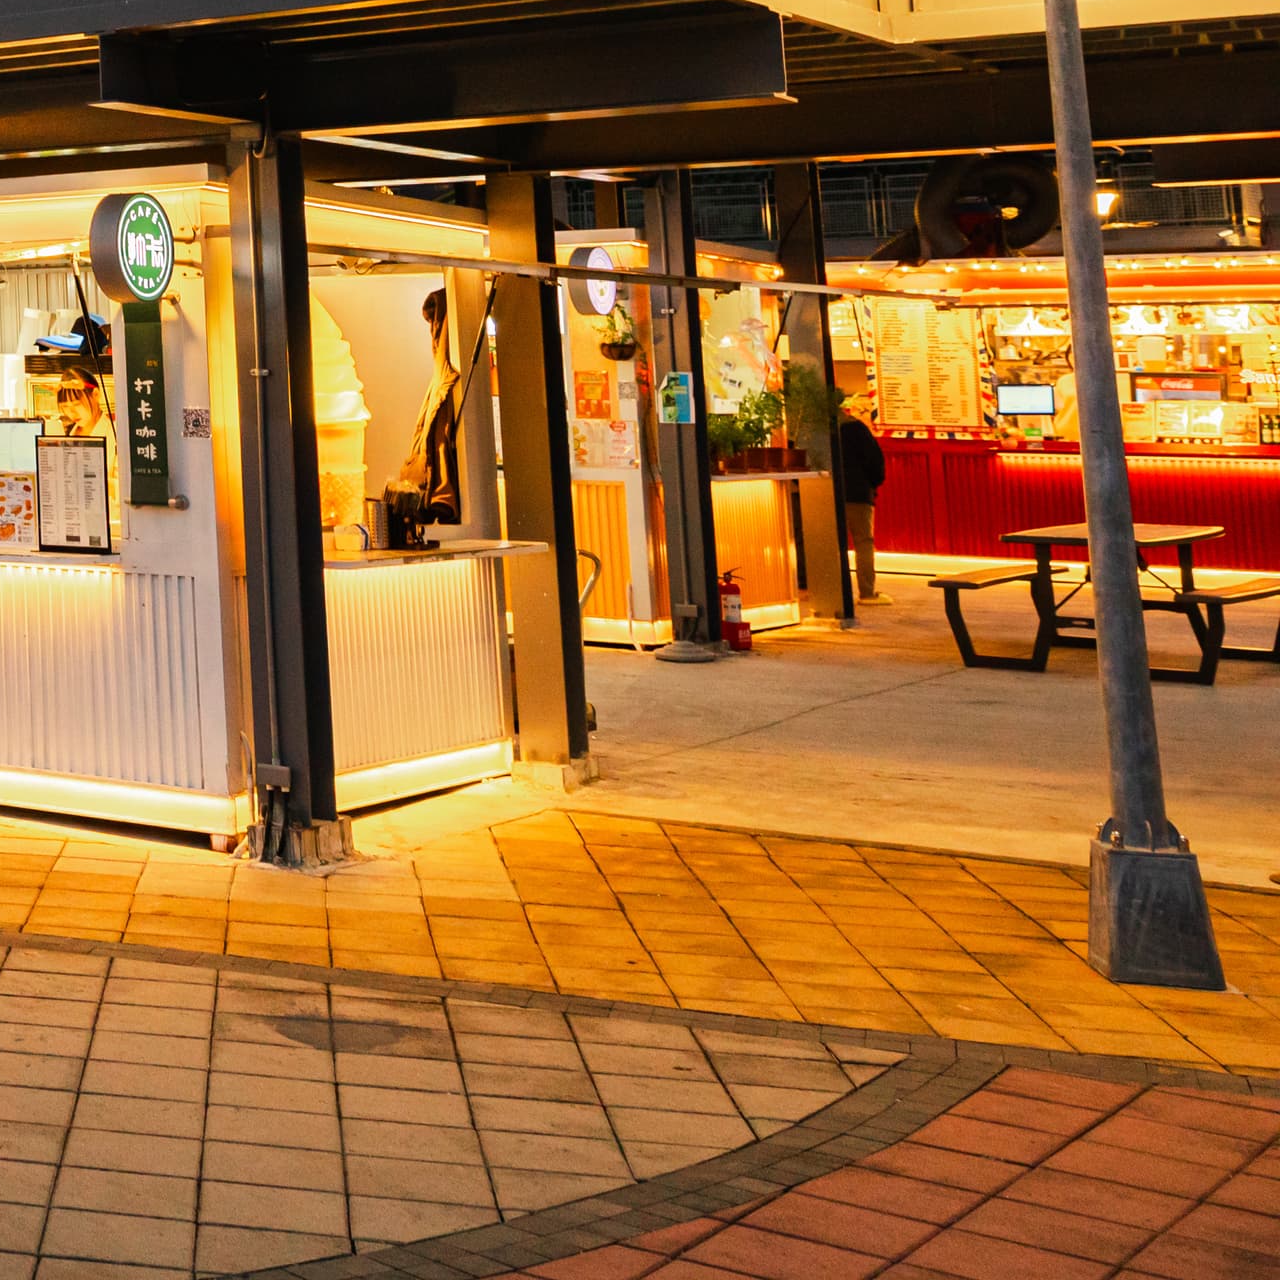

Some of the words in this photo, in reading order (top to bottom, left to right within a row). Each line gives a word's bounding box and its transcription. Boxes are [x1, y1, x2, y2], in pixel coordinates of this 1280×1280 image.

[138, 276, 156, 289] TEA
[1240, 368, 1280, 385] San
[134, 377, 158, 462] 打卡咖啡
